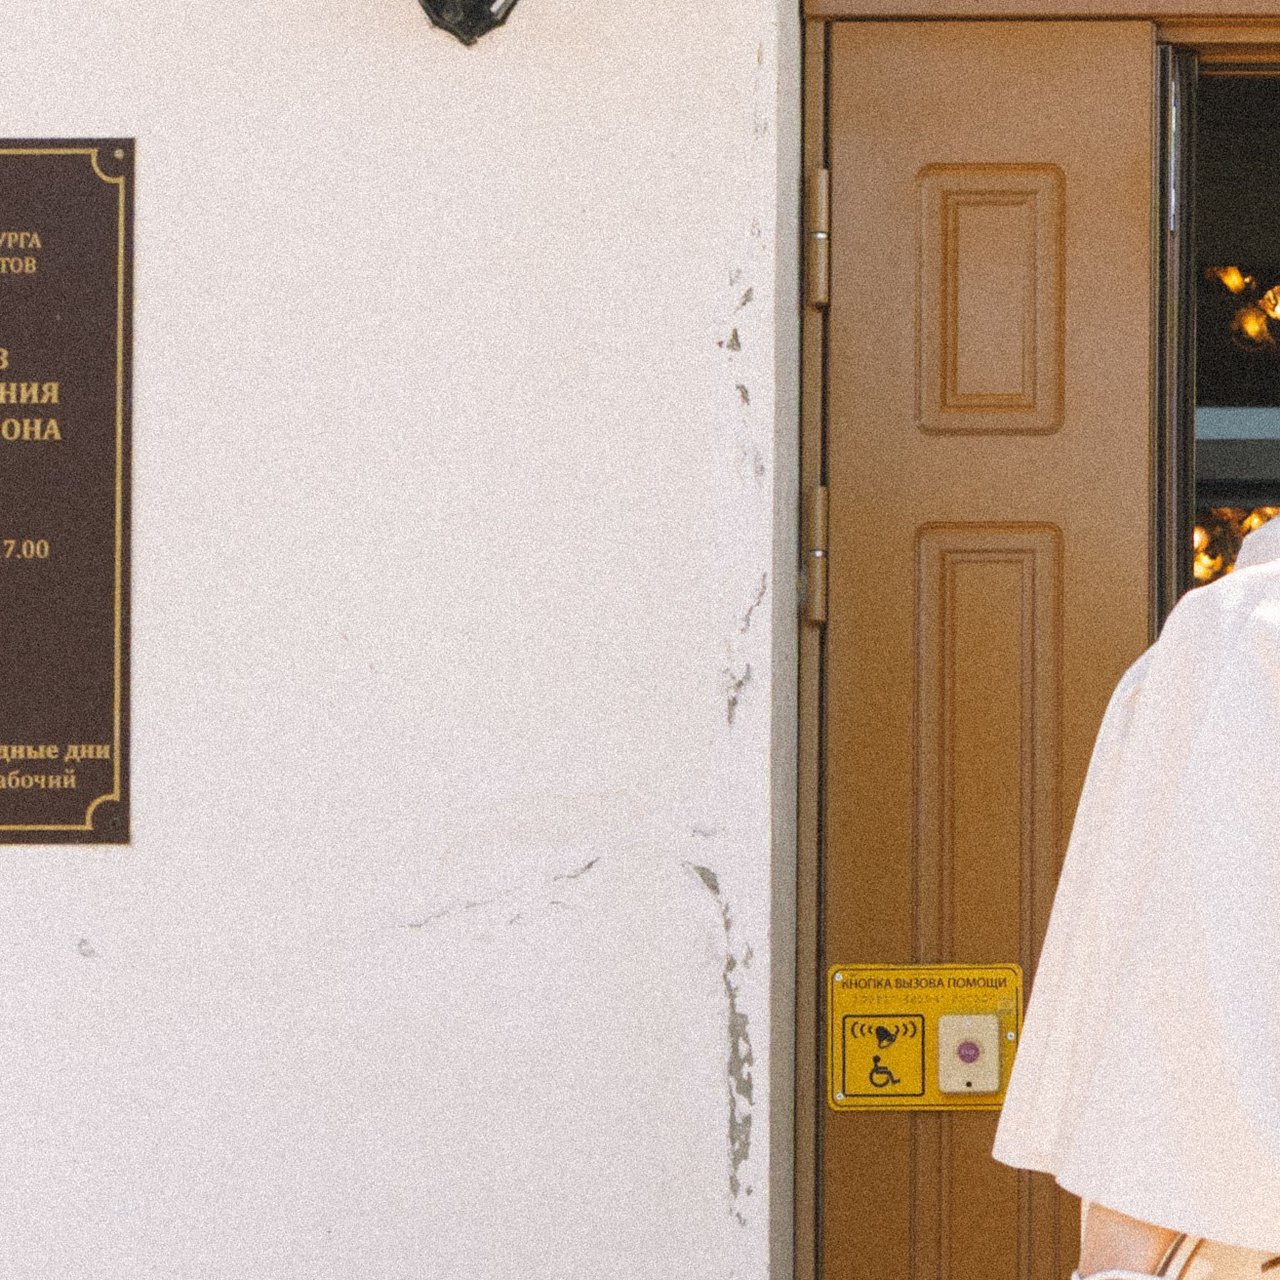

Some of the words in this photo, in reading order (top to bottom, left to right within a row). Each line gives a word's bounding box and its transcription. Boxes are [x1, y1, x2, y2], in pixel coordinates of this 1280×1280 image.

[0, 381, 60, 404] НИЯ
[1, 418, 62, 441] ОНА
[3, 539, 50, 559] 7.00
[64, 744, 111, 763] дни
[841, 976, 892, 989] КНОПКА
[895, 976, 944, 989] ВЫЗОВА
[947, 976, 1007, 990] ПОМОЩИ
